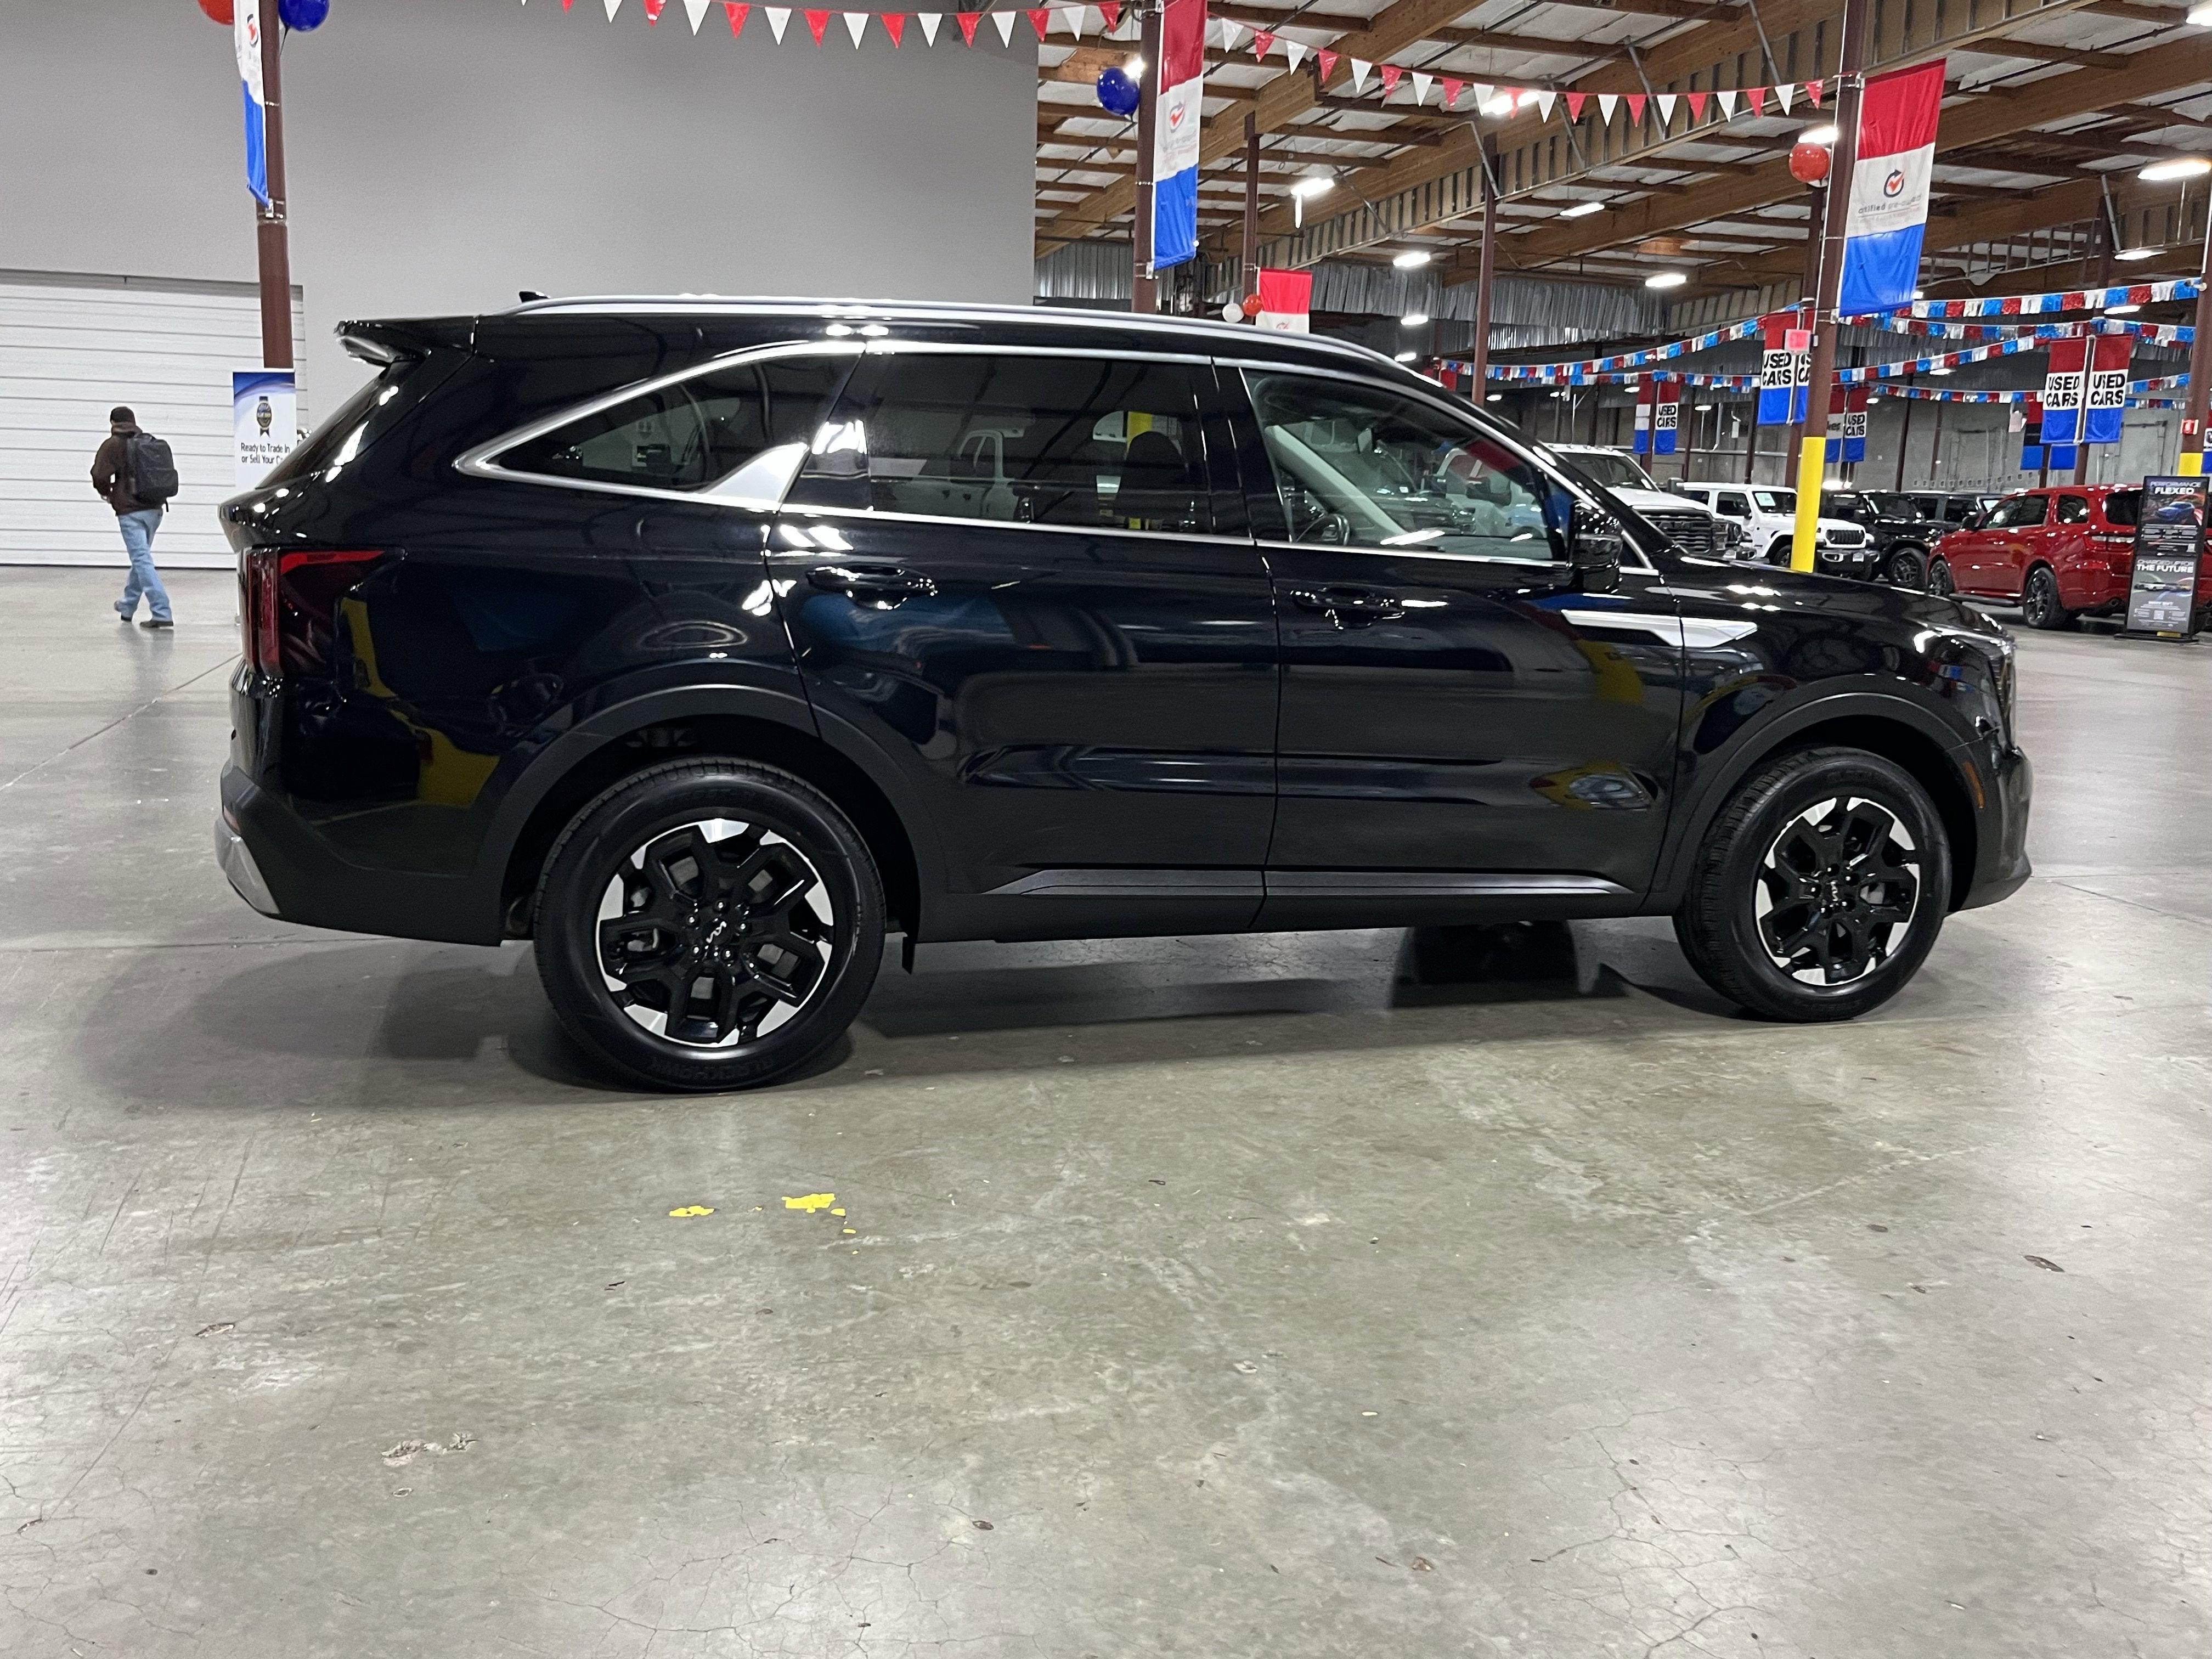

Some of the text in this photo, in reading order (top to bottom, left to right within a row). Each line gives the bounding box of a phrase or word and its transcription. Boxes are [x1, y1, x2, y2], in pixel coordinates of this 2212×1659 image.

[1763, 352, 1792, 369] USED
[1763, 369, 1792, 386] CARS
[2049, 375, 2080, 391] USED
[2094, 373, 2125, 389] USED
[2046, 392, 2078, 408] CARS
[2091, 390, 2124, 405] CARS
[1658, 405, 1676, 415] USED
[241, 442, 258, 455] Ready
[260, 444, 266, 453] to
[267, 443, 283, 453] Trade
[250, 454, 261, 464] Sell
[262, 454, 274, 464] Your
[2154, 487, 2194, 495] FLEXED
